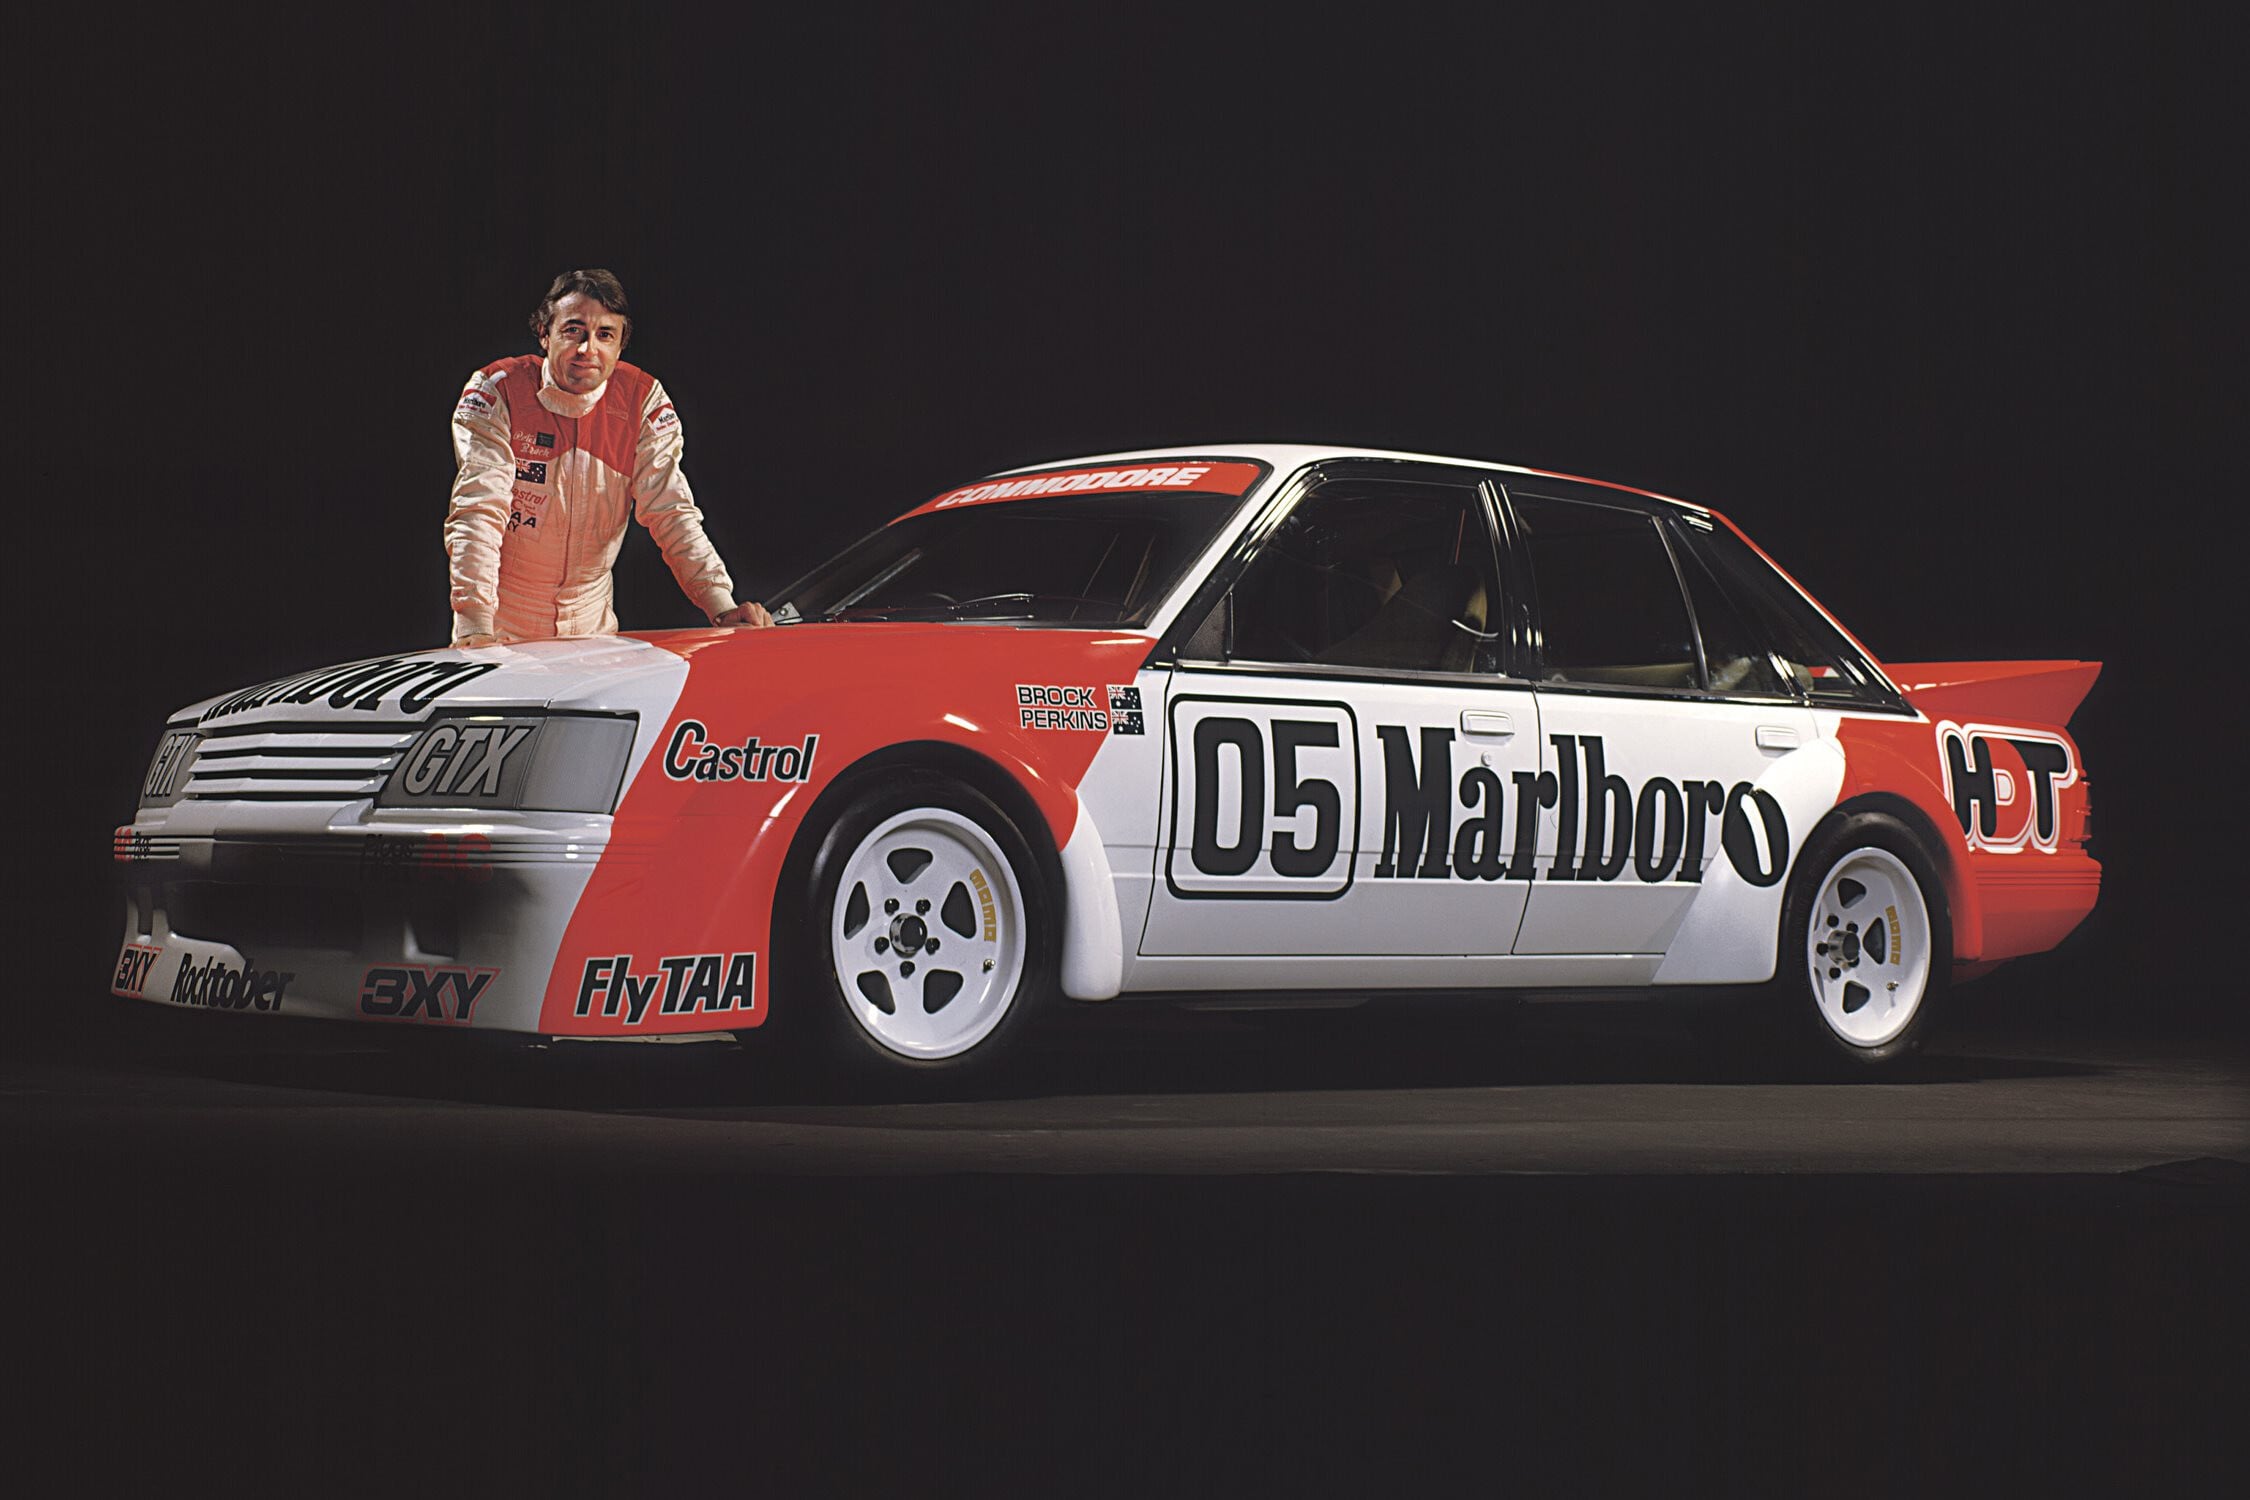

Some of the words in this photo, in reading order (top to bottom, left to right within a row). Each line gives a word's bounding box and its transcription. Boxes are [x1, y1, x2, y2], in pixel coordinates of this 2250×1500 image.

[512, 486, 548, 506] astrol
[934, 467, 1211, 509] COMMODORE
[1017, 686, 1096, 708] BROCK
[1020, 709, 1108, 731] PERKINS
[145, 732, 199, 798] GTX
[403, 724, 537, 798] GTX
[664, 721, 818, 782] Castrol
[1191, 717, 1341, 877] 05
[1374, 724, 1790, 888] Marlboro
[1941, 730, 2071, 846] HDT
[115, 947, 159, 993] 3XY
[170, 953, 296, 1012] Rocktober
[357, 966, 496, 1021] 3XY
